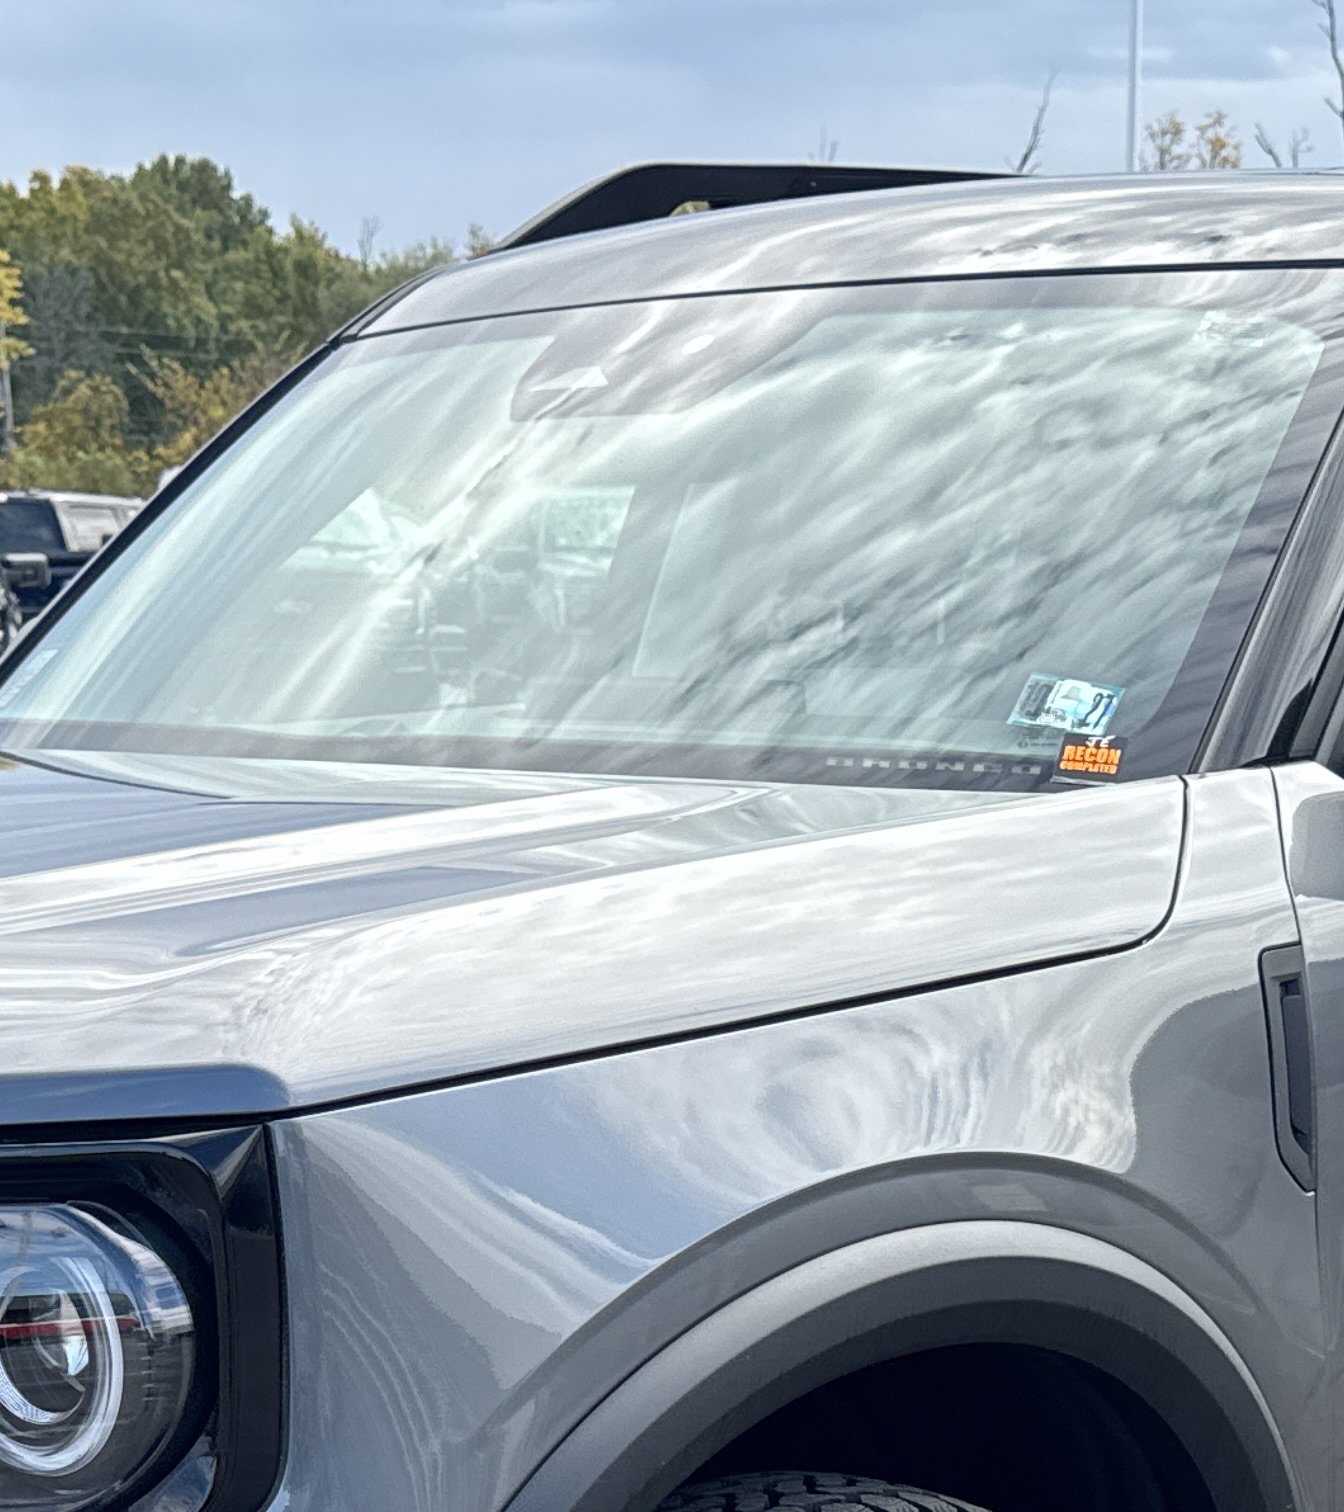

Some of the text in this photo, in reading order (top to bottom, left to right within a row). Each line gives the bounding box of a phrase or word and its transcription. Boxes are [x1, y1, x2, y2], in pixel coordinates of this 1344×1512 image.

[1062, 745, 1122, 765] RECON
[826, 757, 1042, 776] BRONCO
[1059, 761, 1118, 775] COMPLETED
